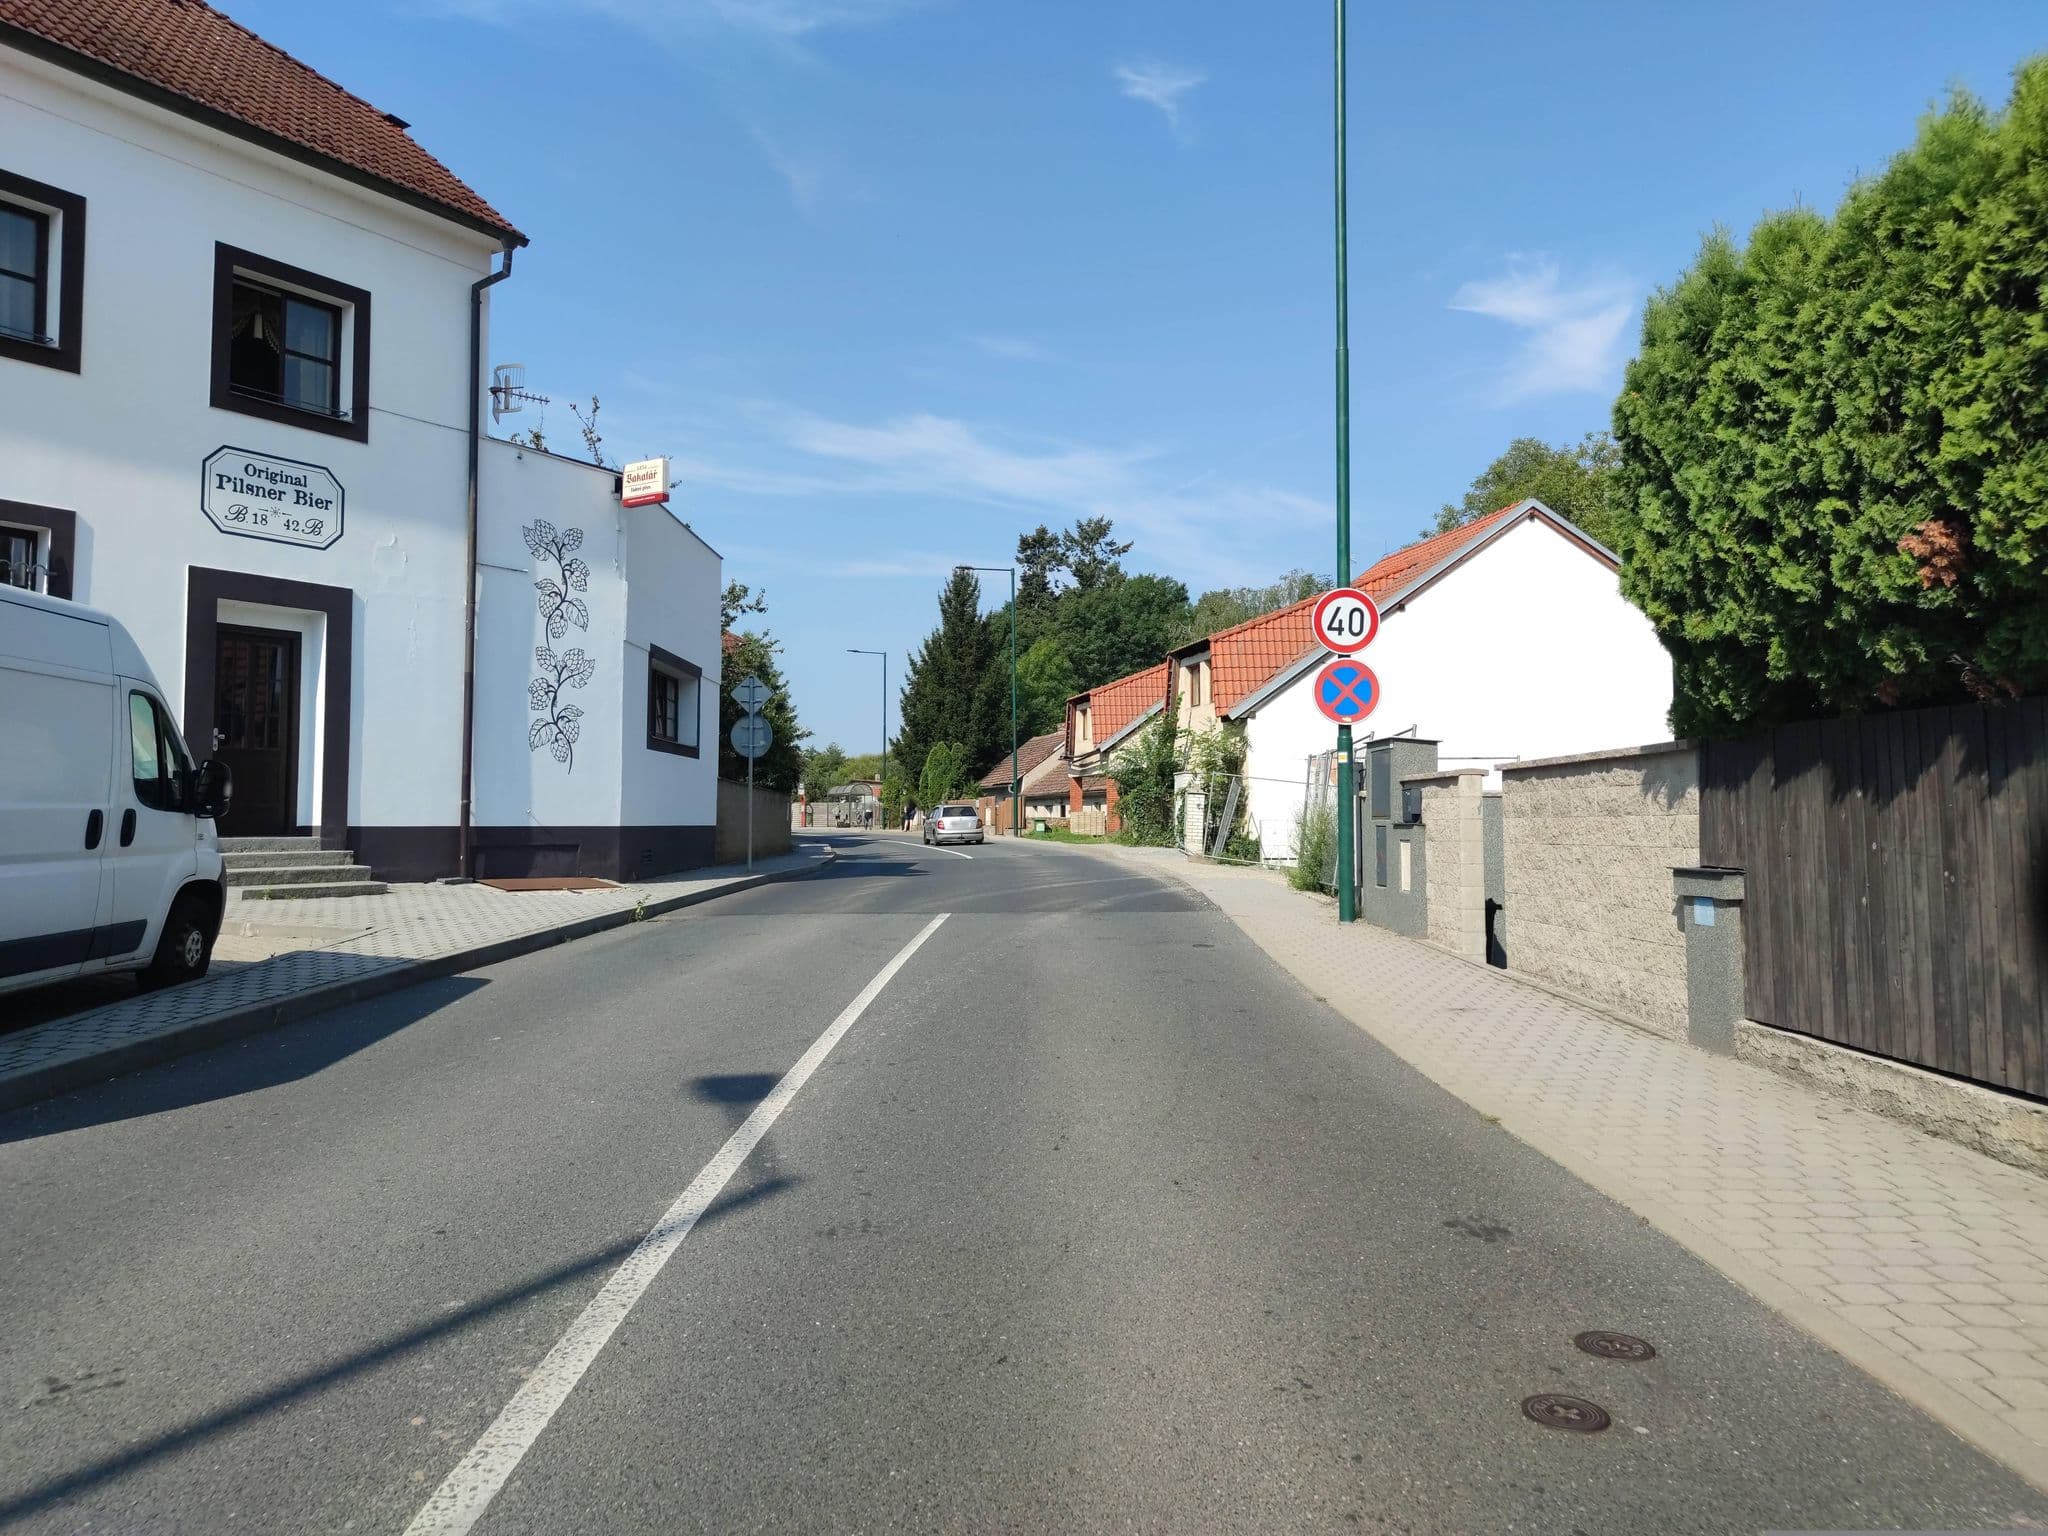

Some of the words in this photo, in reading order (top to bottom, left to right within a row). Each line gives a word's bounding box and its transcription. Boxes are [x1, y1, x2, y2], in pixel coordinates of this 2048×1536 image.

[244, 463, 308, 488] Original
[215, 473, 287, 502] Pilsner
[293, 489, 333, 511] Bier
[1327, 606, 1365, 637] 40
